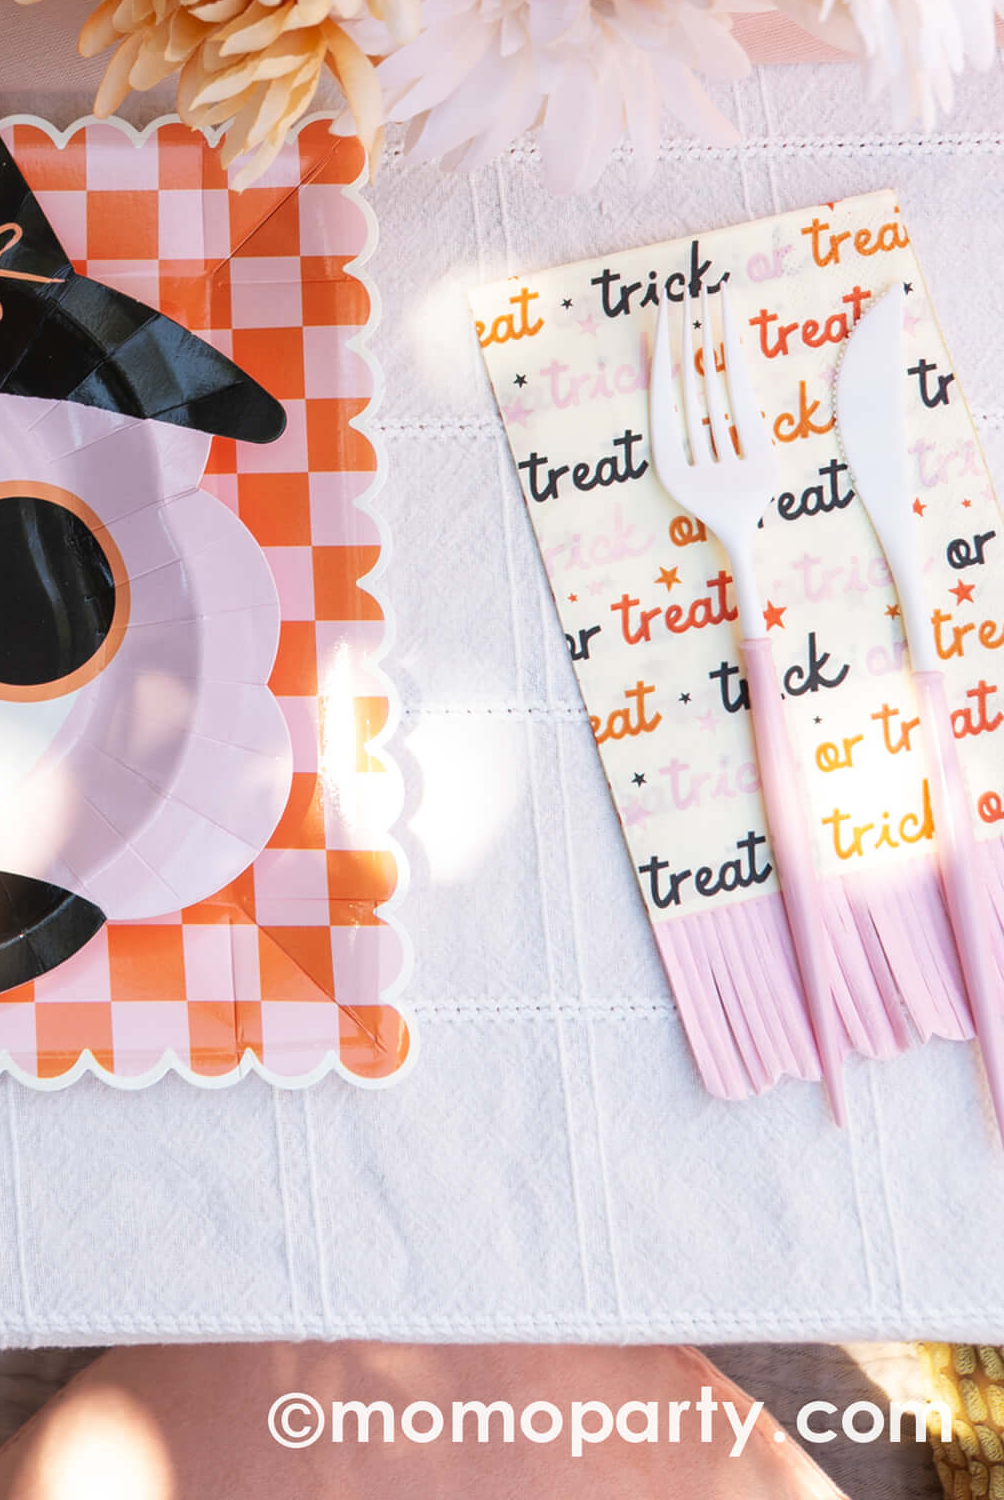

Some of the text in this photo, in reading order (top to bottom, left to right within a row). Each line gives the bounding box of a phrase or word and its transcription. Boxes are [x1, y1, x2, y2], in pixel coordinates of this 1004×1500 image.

[590, 240, 730, 318] trick
[801, 218, 910, 268] trea
[748, 286, 872, 359] treat
[518, 429, 649, 503] treat
[757, 458, 856, 529] eat
[610, 570, 739, 645] treat
[792, 552, 895, 602] tric
[947, 530, 997, 570] or
[708, 631, 850, 714] trck
[659, 757, 762, 811] tric
[815, 733, 864, 773] or
[638, 831, 773, 909] treat
